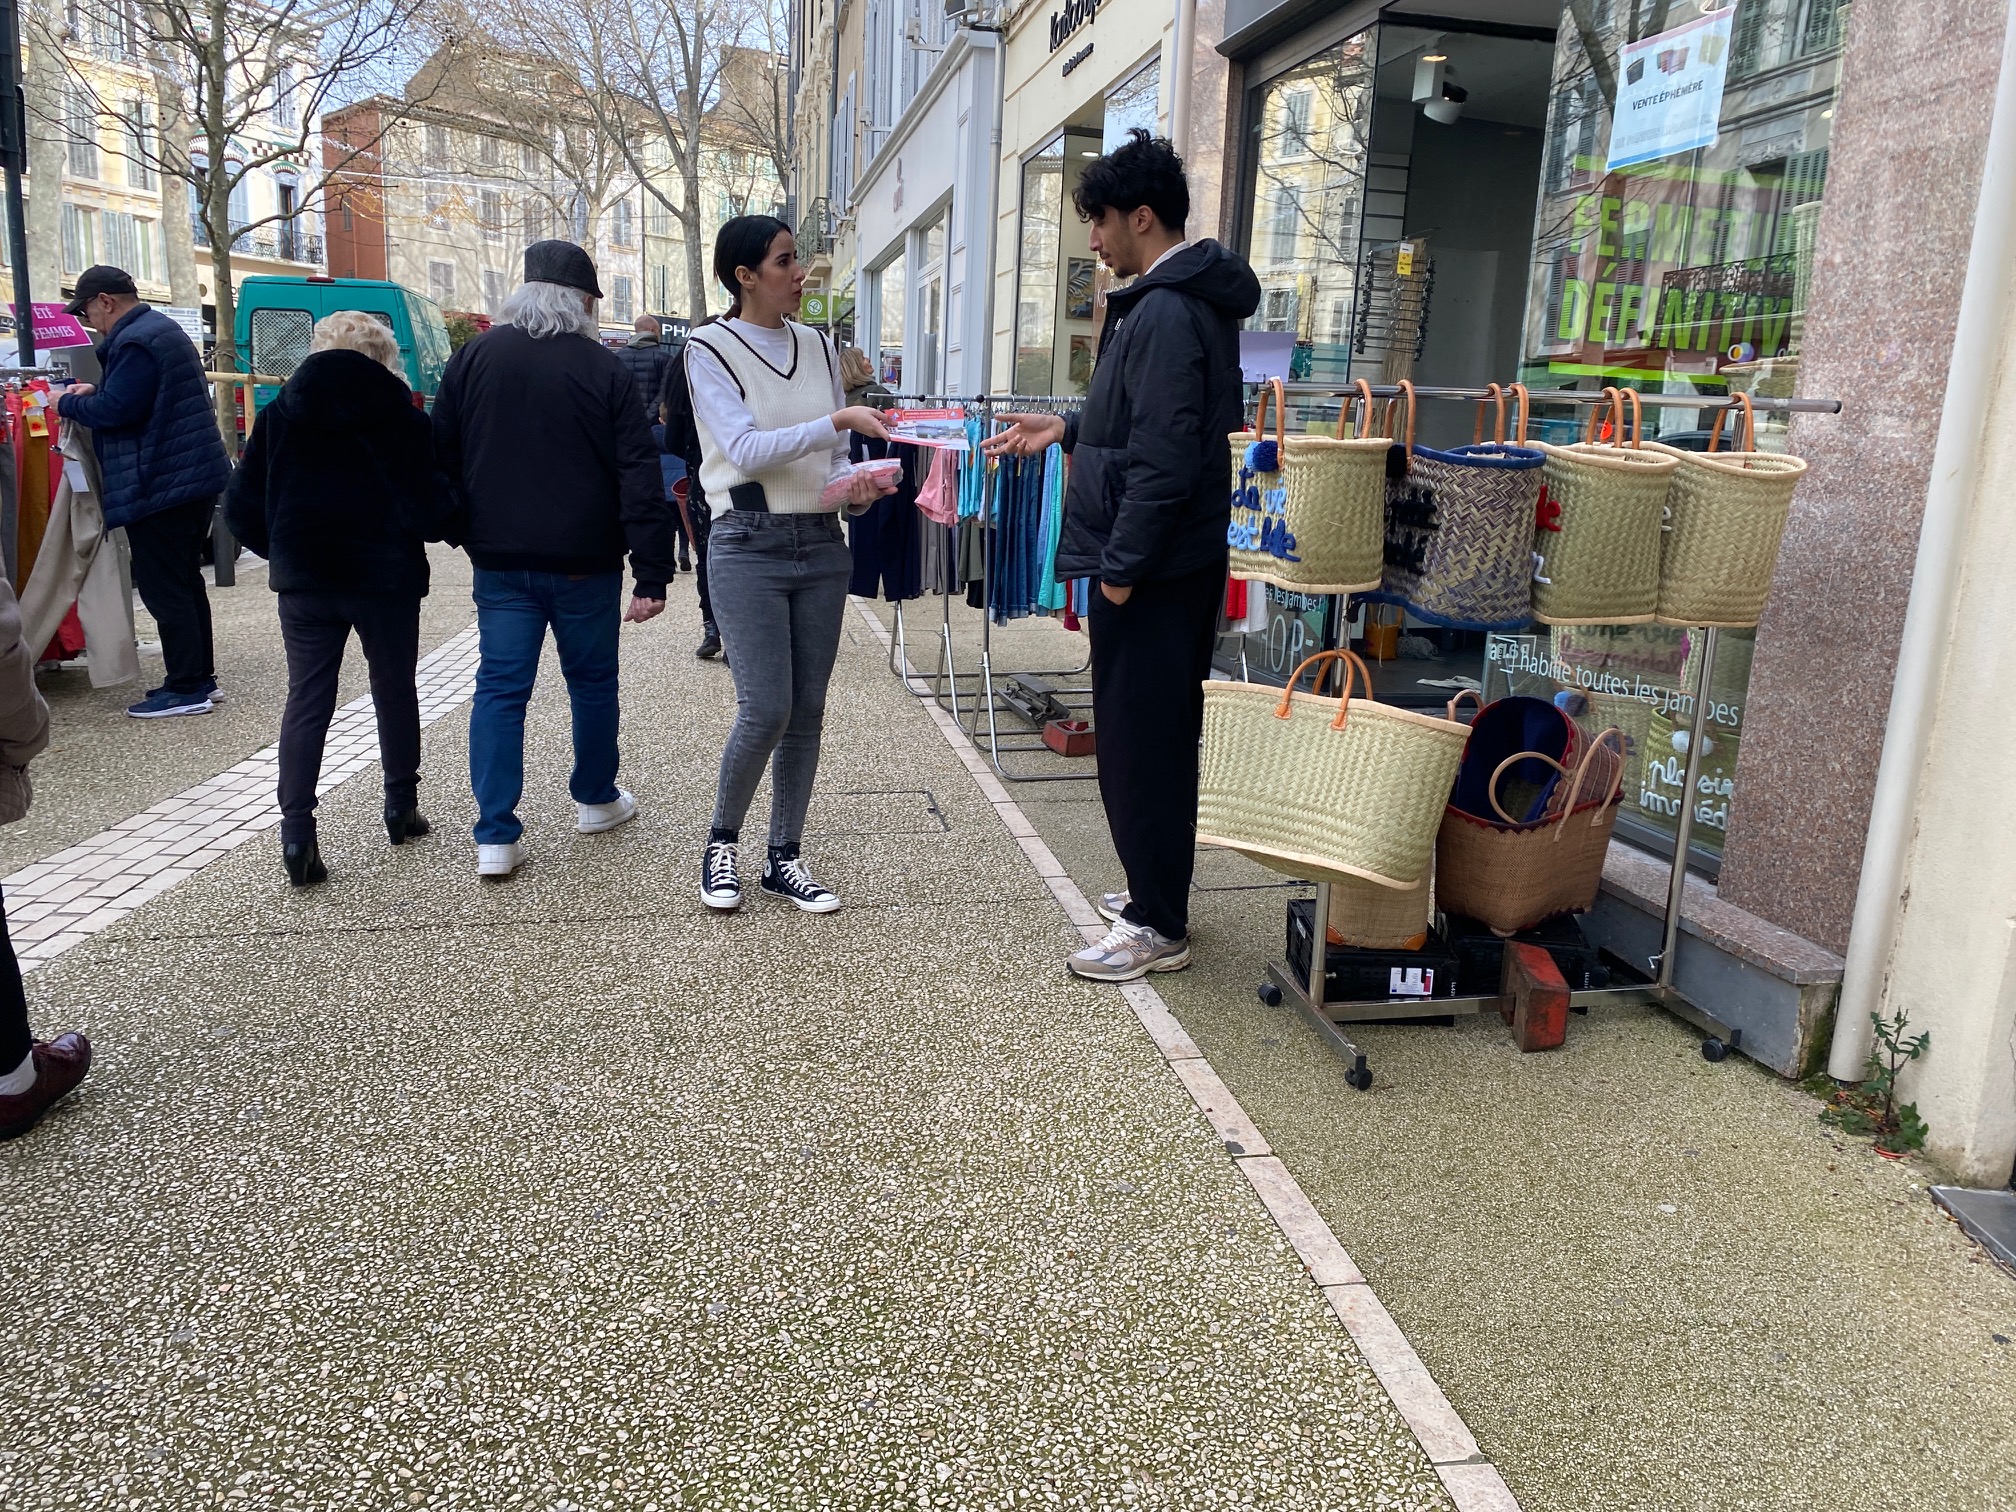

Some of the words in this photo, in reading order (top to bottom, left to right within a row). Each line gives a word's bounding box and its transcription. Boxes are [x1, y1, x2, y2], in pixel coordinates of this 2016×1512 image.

[1632, 93, 1659, 111] VENTE
[1659, 80, 1704, 103] ÉPHÉMÈRE
[32, 305, 56, 319] ÉTÉ
[32, 325, 76, 340] FEMMES
[1576, 664, 1630, 698] toutes
[1634, 675, 1659, 706] les
